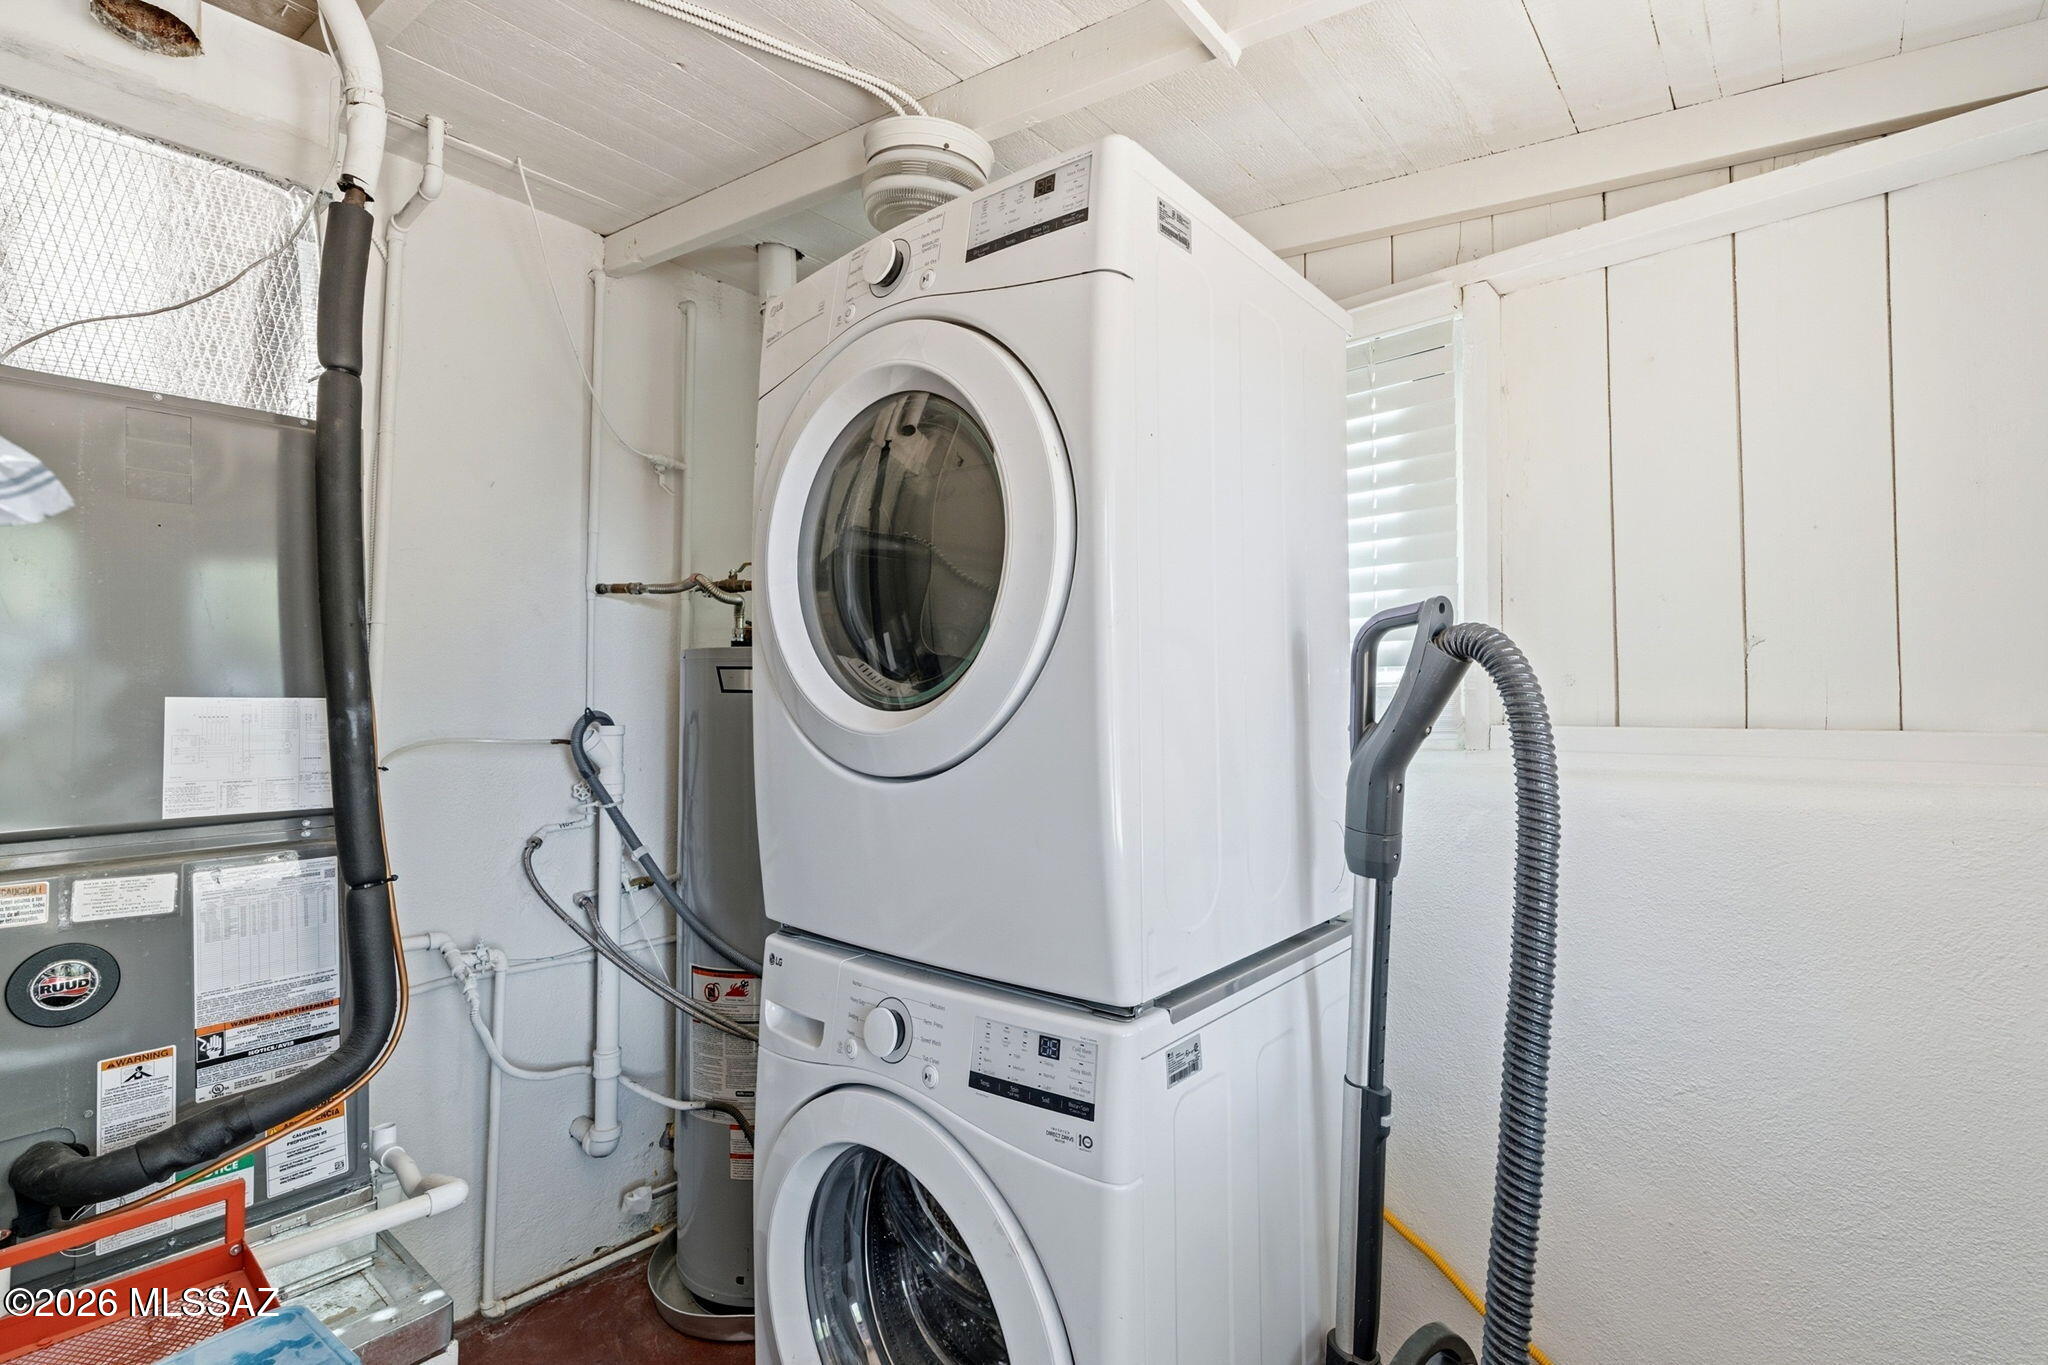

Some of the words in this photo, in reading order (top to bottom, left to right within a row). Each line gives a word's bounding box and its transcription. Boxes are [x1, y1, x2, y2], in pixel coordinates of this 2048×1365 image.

[39, 978, 91, 995] RUUD
[115, 1049, 169, 1067] WARNING
[1079, 1134, 1093, 1149] 10
